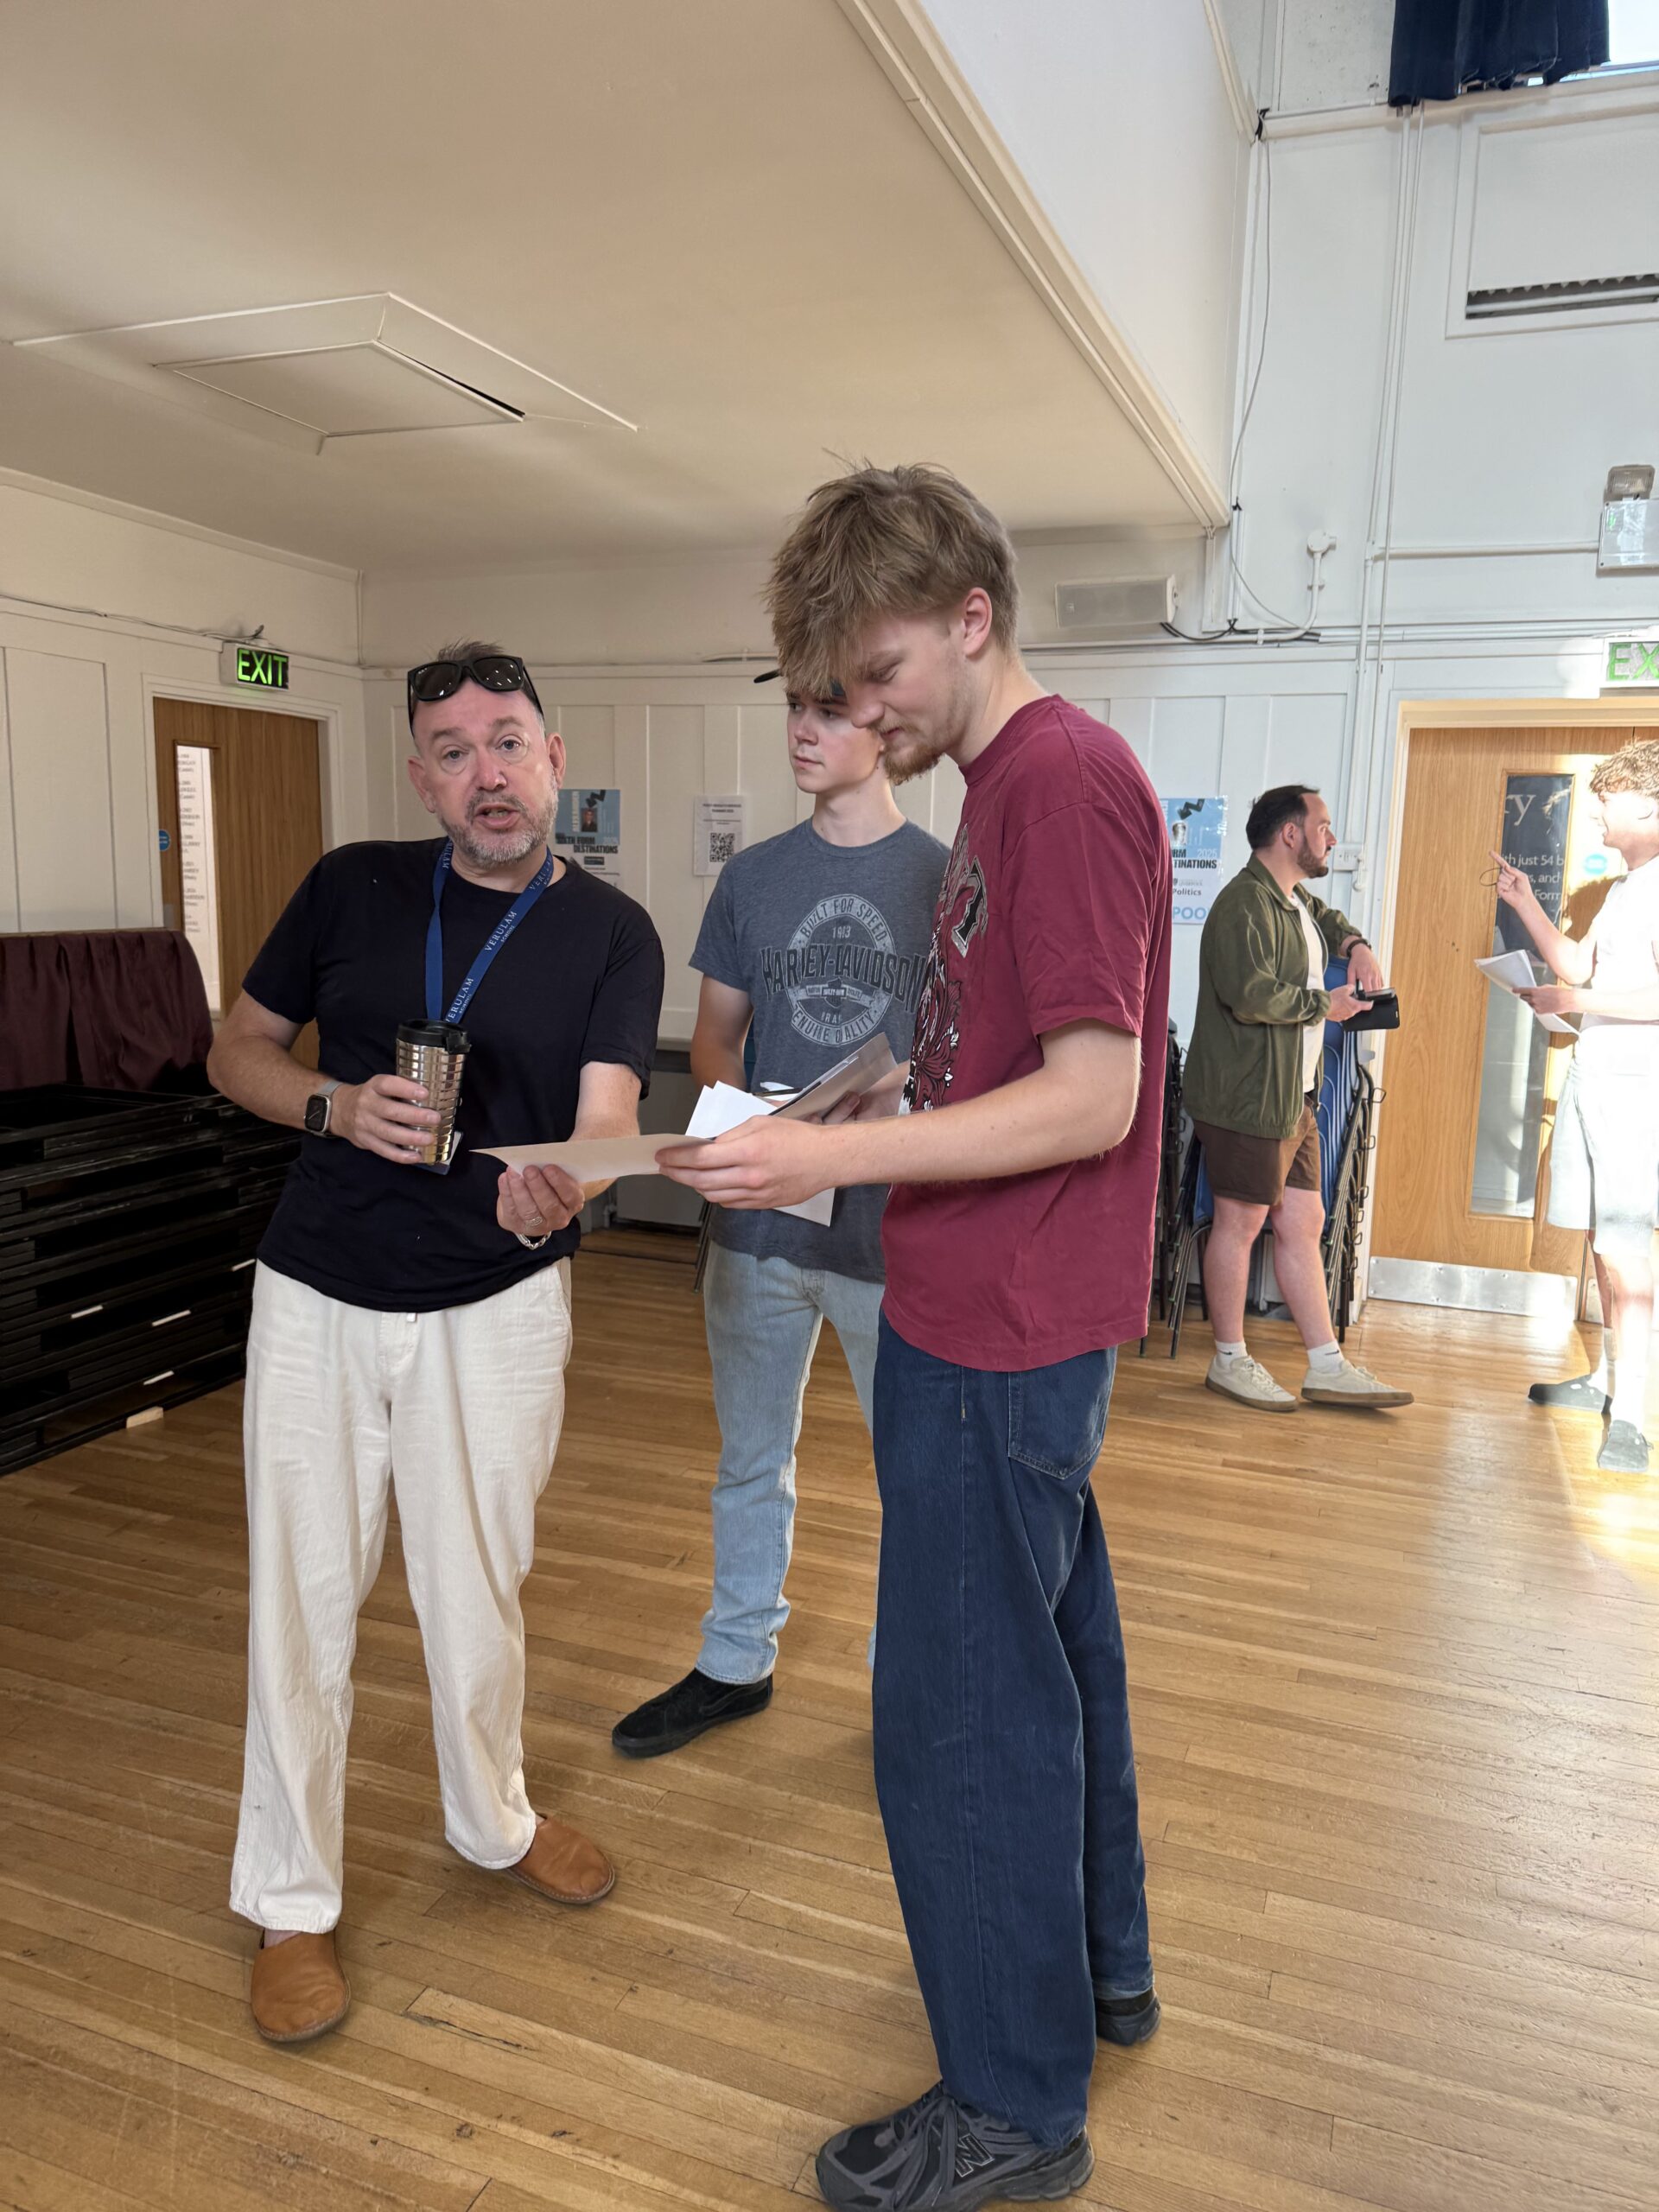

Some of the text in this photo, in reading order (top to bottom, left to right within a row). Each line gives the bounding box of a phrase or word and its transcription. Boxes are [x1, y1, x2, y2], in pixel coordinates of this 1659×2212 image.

[238, 649, 288, 687] EXIT
[1608, 642, 1659, 680] EX
[1517, 854, 1539, 868] just
[1541, 855, 1554, 866] 54
[1538, 871, 1560, 883] and
[484, 911, 517, 950] VERULAM
[833, 898, 855, 914] FOR
[856, 903, 887, 942] SPEED
